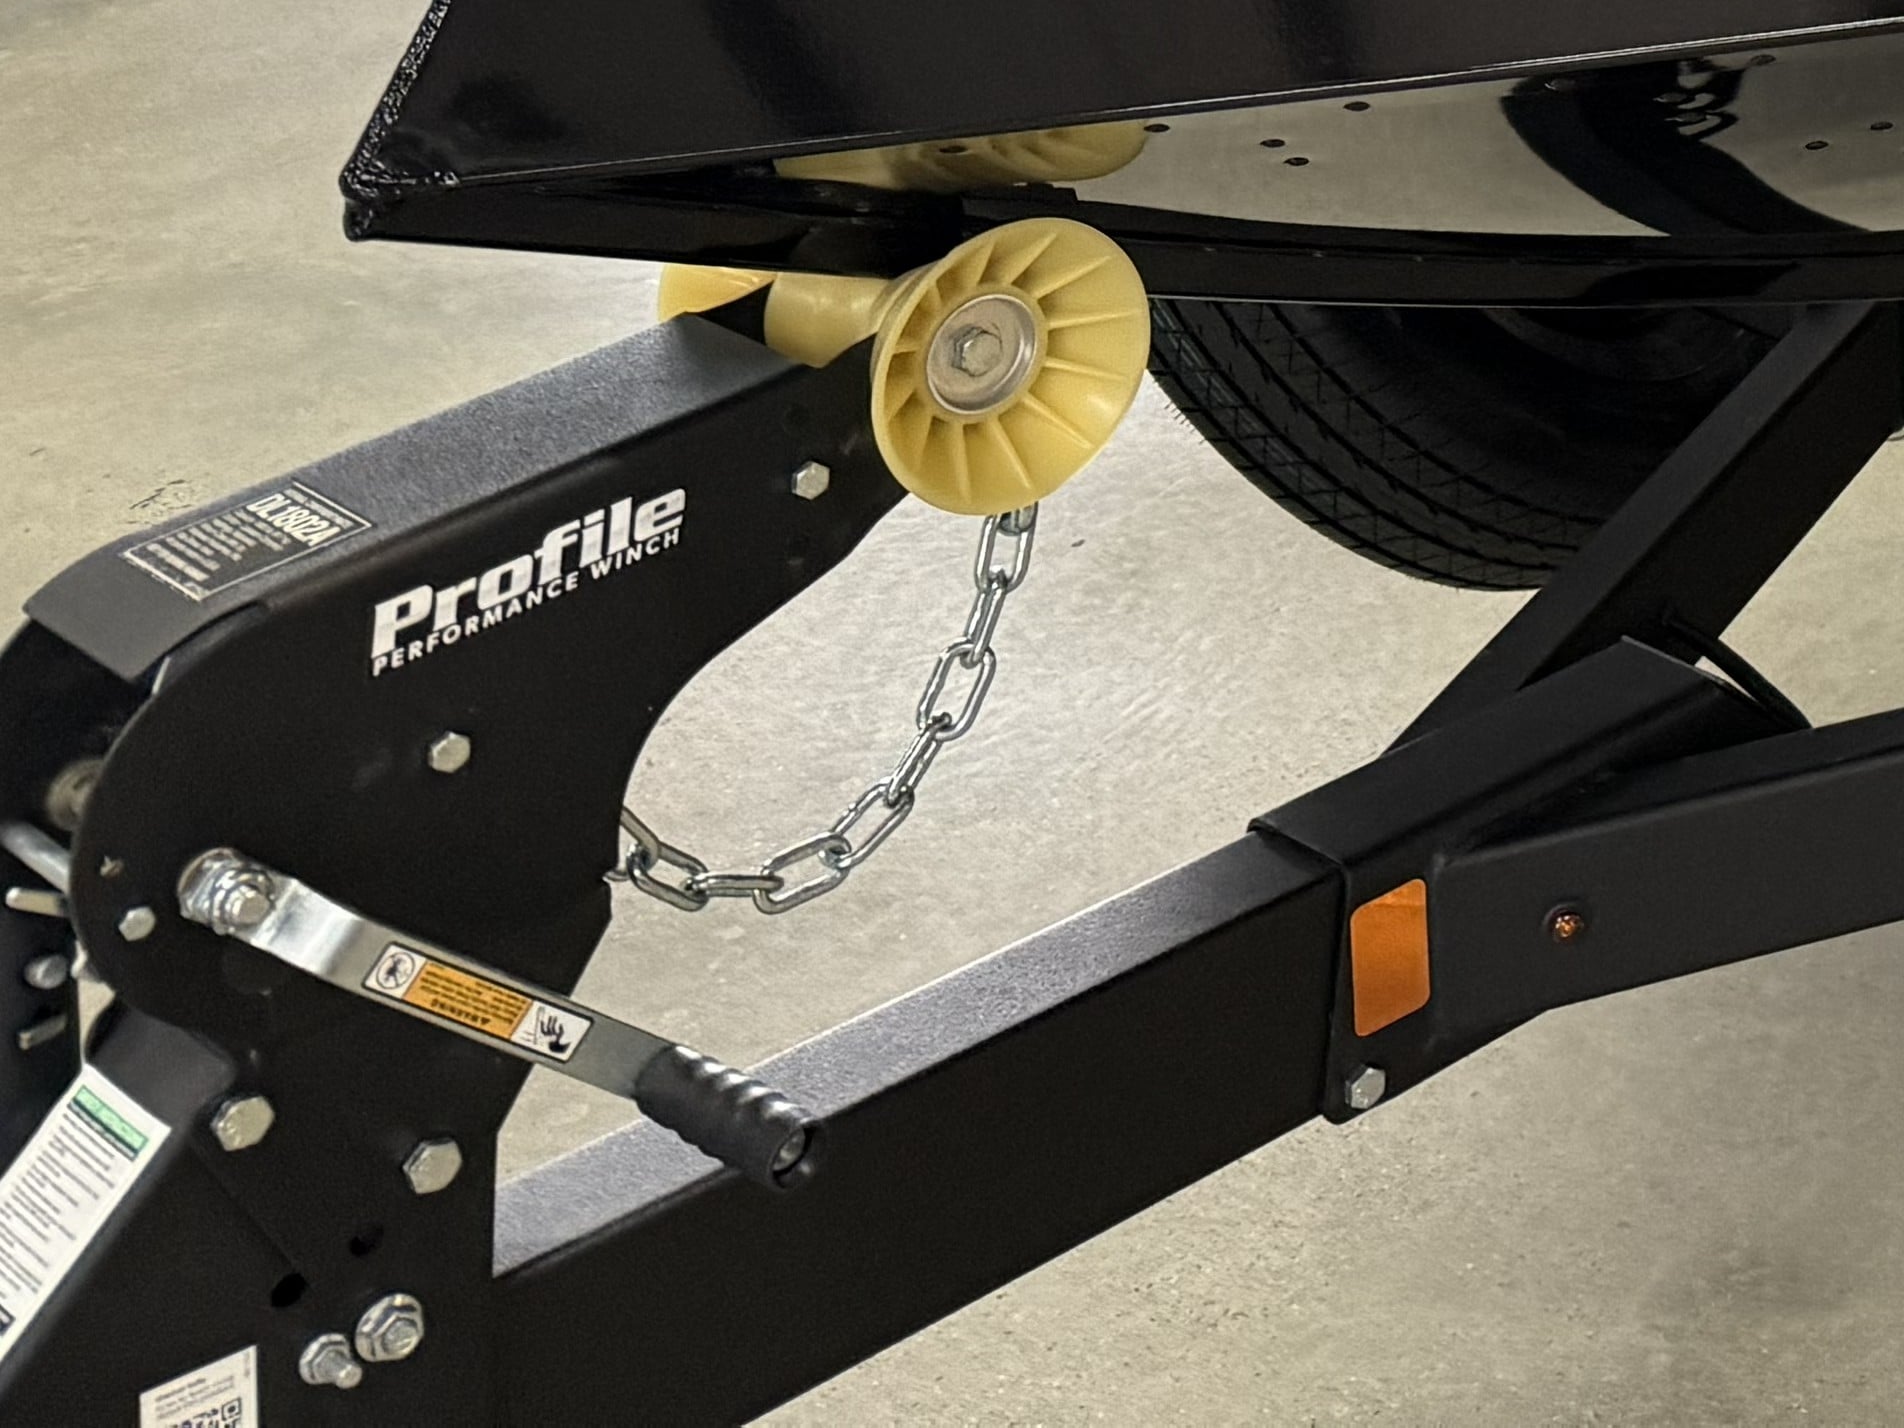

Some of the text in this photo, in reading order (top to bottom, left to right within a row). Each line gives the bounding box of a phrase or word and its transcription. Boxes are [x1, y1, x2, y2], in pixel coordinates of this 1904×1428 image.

[246, 493, 341, 547] DL1802A
[371, 488, 686, 659] Profile
[371, 527, 680, 677] PERFORMANCE WINCH
